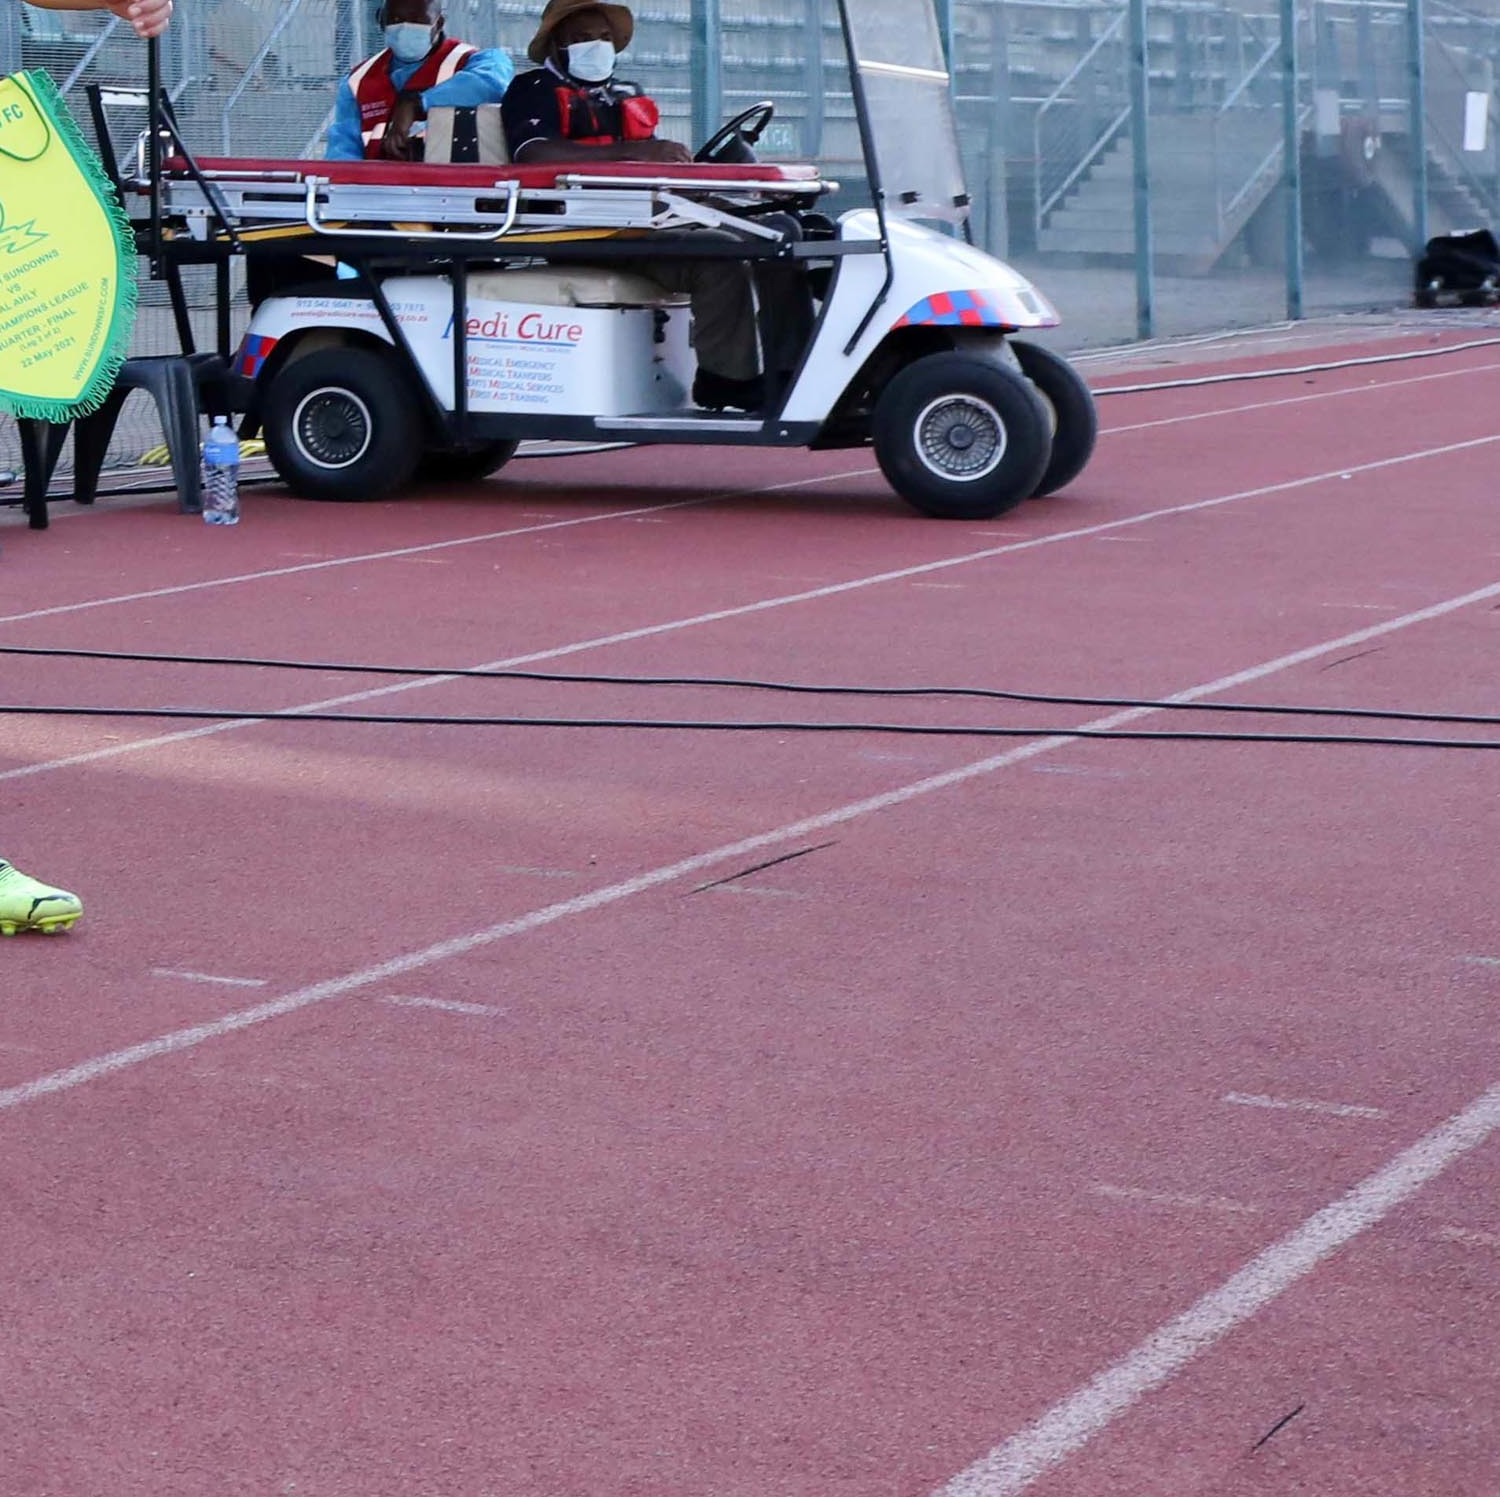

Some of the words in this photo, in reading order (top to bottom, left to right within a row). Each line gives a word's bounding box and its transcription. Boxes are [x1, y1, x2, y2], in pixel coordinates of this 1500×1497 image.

[2, 103, 24, 123] FC
[3, 249, 59, 281] SUNDOWNS
[13, 288, 39, 306] AHLY
[49, 281, 89, 307] LEAGUE
[47, 307, 77, 325] FINAL
[516, 312, 584, 342] Cure
[33, 349, 54, 363] May
[54, 336, 76, 352] 2021
